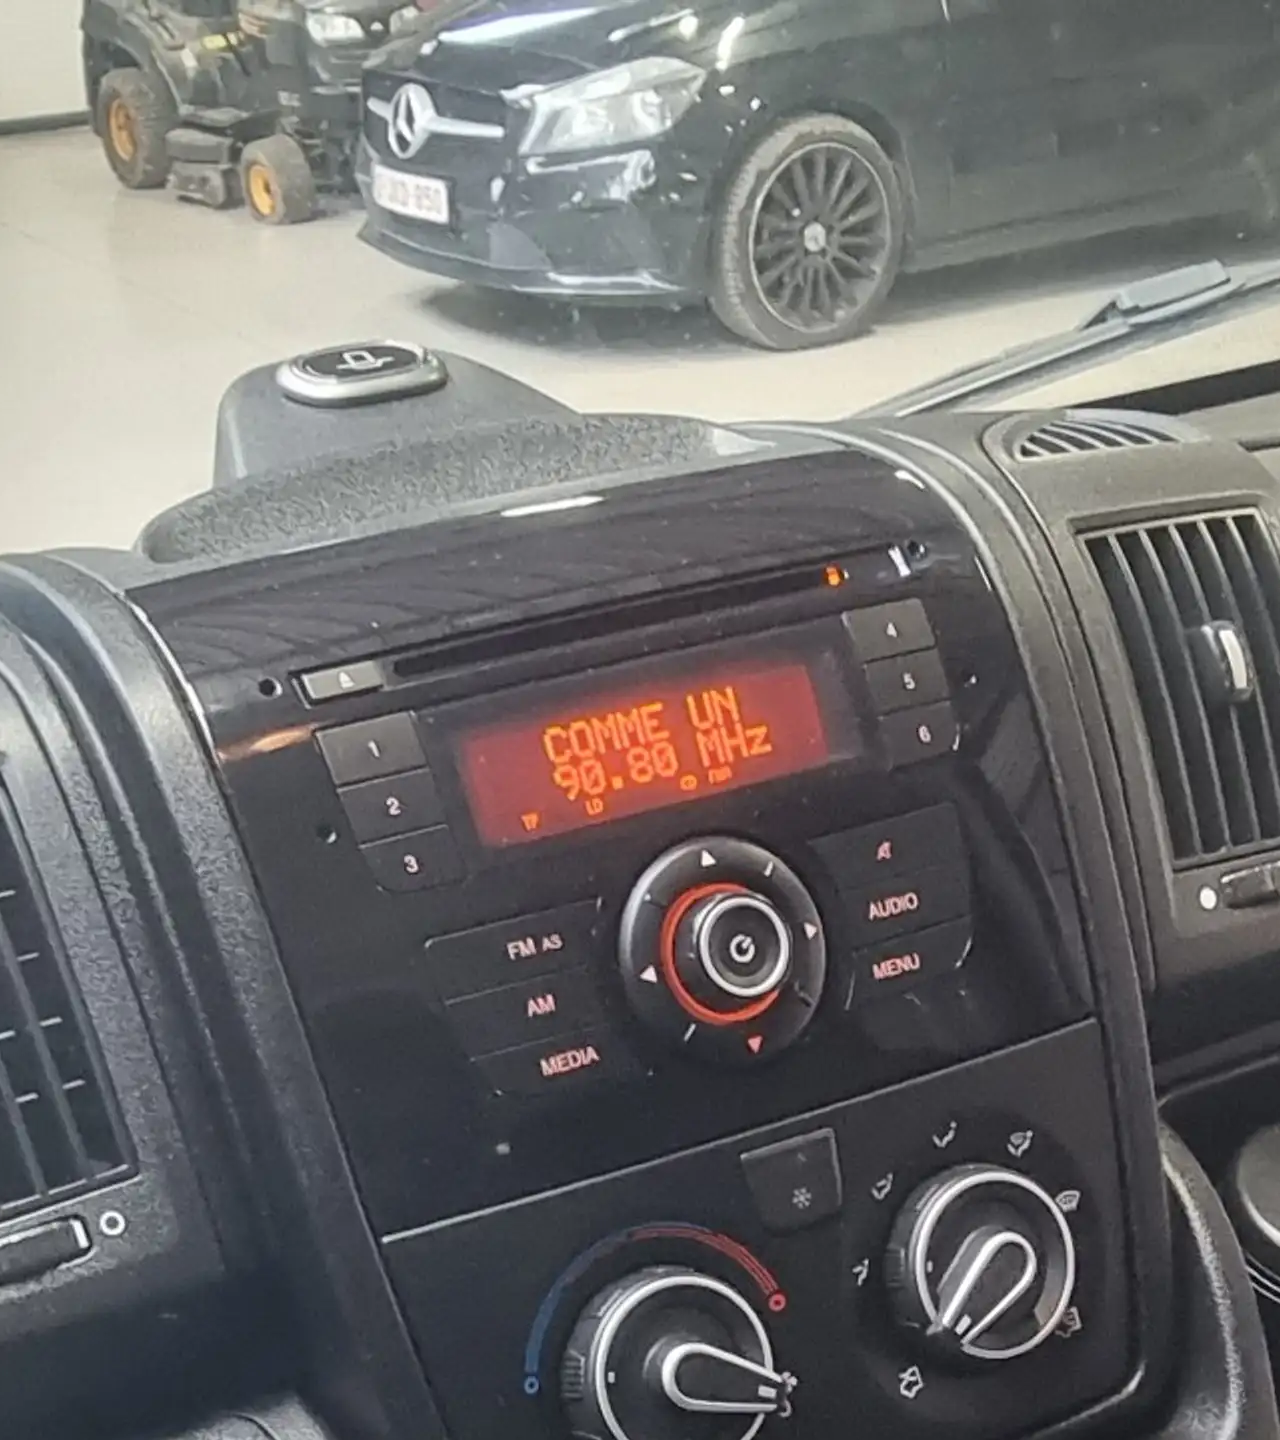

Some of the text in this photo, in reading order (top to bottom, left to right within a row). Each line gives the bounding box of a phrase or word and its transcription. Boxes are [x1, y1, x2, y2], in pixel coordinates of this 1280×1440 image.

[886, 621, 898, 638] 4
[903, 672, 916, 690] 5
[544, 686, 741, 764] COMME UN
[919, 725, 932, 743] 6
[368, 739, 381, 758] 1
[553, 724, 772, 801] 90.80 MHz
[386, 796, 402, 816] 2
[404, 854, 419, 874] 3
[868, 891, 919, 921] AUDIO
[506, 933, 563, 960] FM AS
[872, 952, 921, 980] MENU
[526, 994, 557, 1017] AM
[539, 1046, 601, 1077] MEDIA
